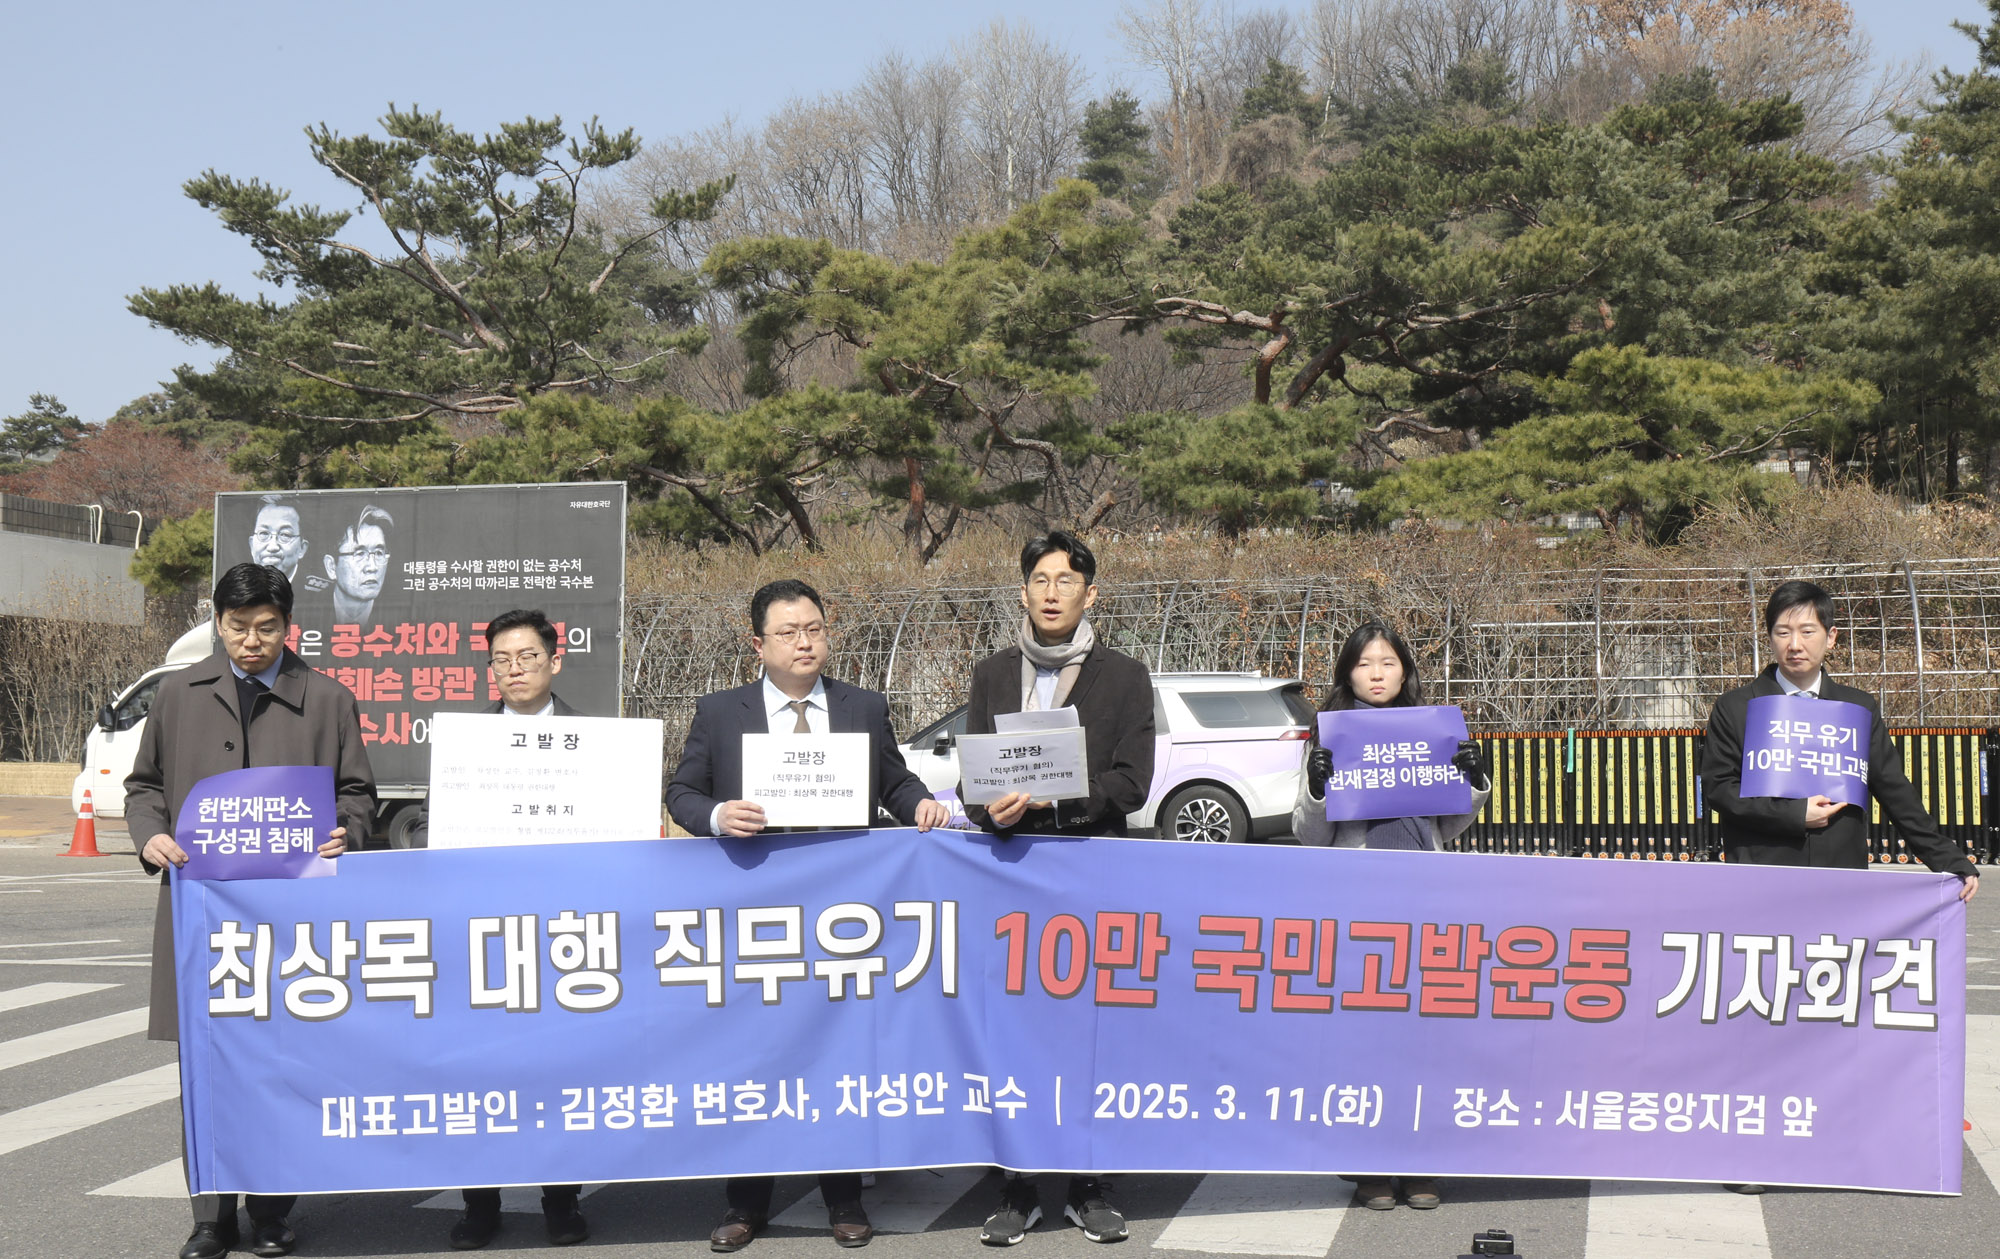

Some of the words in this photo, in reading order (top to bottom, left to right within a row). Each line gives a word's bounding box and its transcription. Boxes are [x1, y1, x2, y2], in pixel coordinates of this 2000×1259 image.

[570, 500, 611, 509] 자유대한호국단
[403, 560, 447, 574] 대통령을
[450, 559, 483, 574] 수사할
[486, 559, 519, 573] 권한이
[523, 559, 545, 573] 없는
[548, 558, 582, 572] 공수처
[403, 578, 425, 591] 그런
[428, 577, 472, 591] 공수처의
[475, 576, 520, 590] 따까리로
[523, 575, 557, 589] 전락한
[560, 575, 594, 589] 국수본
[331, 622, 460, 658] 공수처와
[412, 666, 477, 701] 방관
[1769, 720, 1813, 744] 직무
[1817, 724, 1857, 751] 유기
[783, 751, 826, 765] 고발장
[999, 745, 1042, 759] 고발장
[1362, 741, 1431, 764] 최상목은
[1747, 748, 1794, 772] 10만
[773, 774, 810, 783] (직무유기
[815, 774, 835, 783] 혐의)
[974, 778, 1006, 786] 피고발인
[1013, 774, 1036, 784] 최상목
[1041, 771, 1073, 780] 권한대행
[990, 765, 1028, 774] (직무유기
[1033, 761, 1053, 770] 혐의)
[1328, 767, 1396, 790] 헌재결정
[1400, 764, 1465, 787] 이행하라
[754, 789, 786, 797] 피고발인
[793, 789, 817, 798] 최상목
[821, 789, 854, 797] 권한대행
[198, 797, 312, 822] 헌법재판소
[192, 827, 260, 855] 구성권
[267, 827, 313, 853] 침해
[208, 918, 437, 1021] 최상목
[468, 910, 623, 1013] 대행
[654, 900, 959, 1008] 직무유기
[995, 911, 1170, 1008] 10만
[1193, 915, 1631, 1023] 국민고발운동
[1655, 931, 1938, 1031] 기자회견
[322, 1090, 519, 1138] 대표고발인
[560, 1083, 678, 1131] 김정환
[693, 1078, 820, 1126] 변호사,
[835, 1072, 949, 1119] 차성안
[962, 1072, 1028, 1120] 교수
[1093, 1082, 1199, 1120] 2025.
[1213, 1084, 1247, 1120] 3.
[1265, 1083, 1384, 1128] 11.(화)
[1452, 1087, 1520, 1127] 장소
[1555, 1089, 1766, 1135] 서울중앙지검
[1782, 1096, 1818, 1138] 앞
